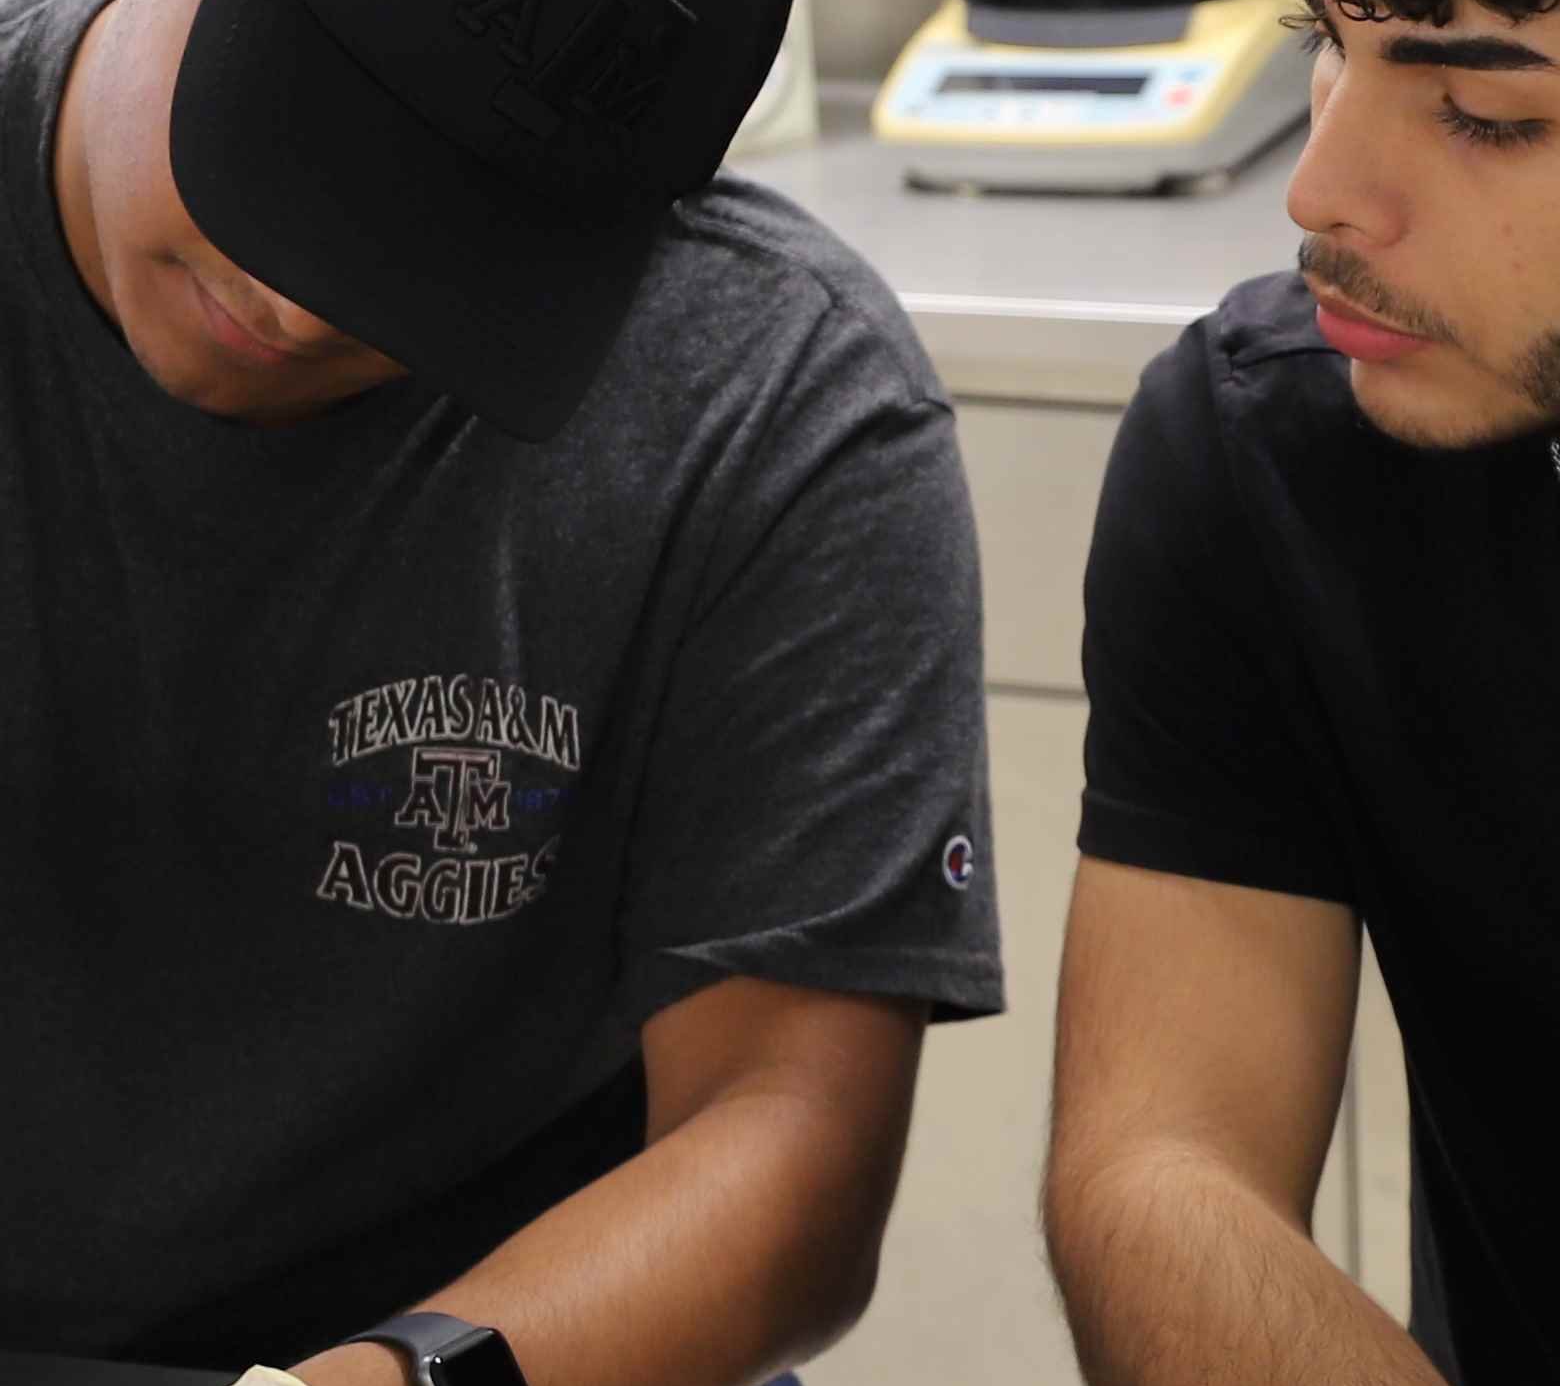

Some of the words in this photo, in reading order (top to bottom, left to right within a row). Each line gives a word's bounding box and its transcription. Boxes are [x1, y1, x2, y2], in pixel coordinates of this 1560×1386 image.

[328, 674, 476, 766] TEXAS
[476, 677, 582, 772] A&M
[316, 834, 562, 926] AGGIES
